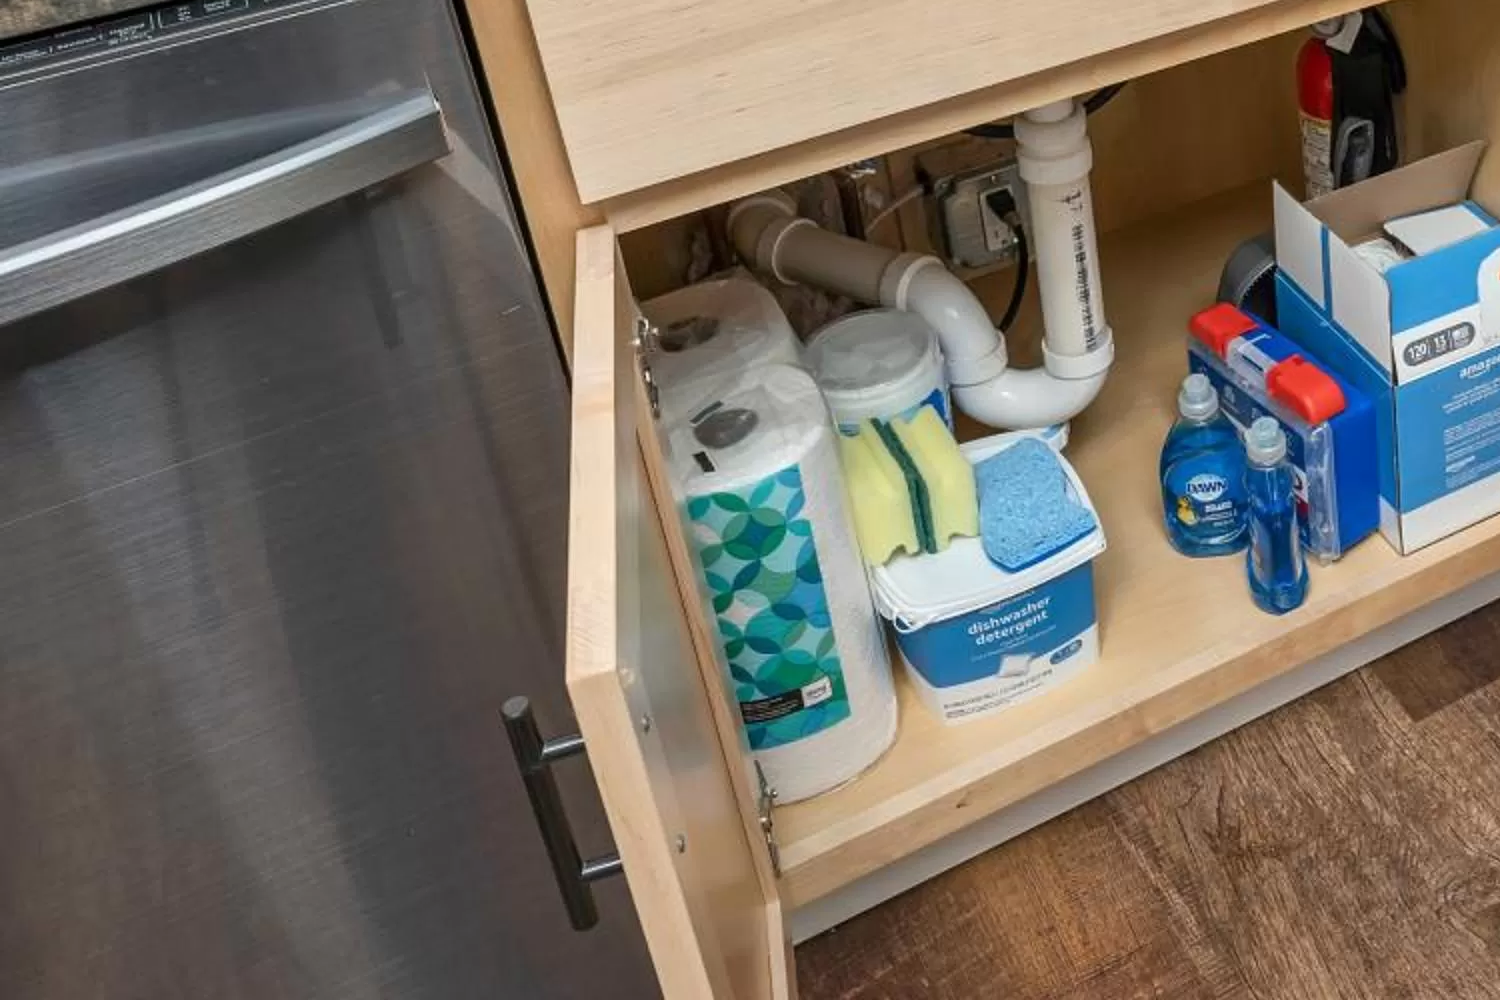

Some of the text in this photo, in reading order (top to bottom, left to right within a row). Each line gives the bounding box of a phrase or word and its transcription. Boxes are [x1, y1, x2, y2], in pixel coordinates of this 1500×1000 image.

[1407, 342, 1428, 361] 120
[1186, 478, 1228, 494] DAWN
[967, 596, 1051, 635] dishwasher
[975, 609, 1049, 646] detergent
